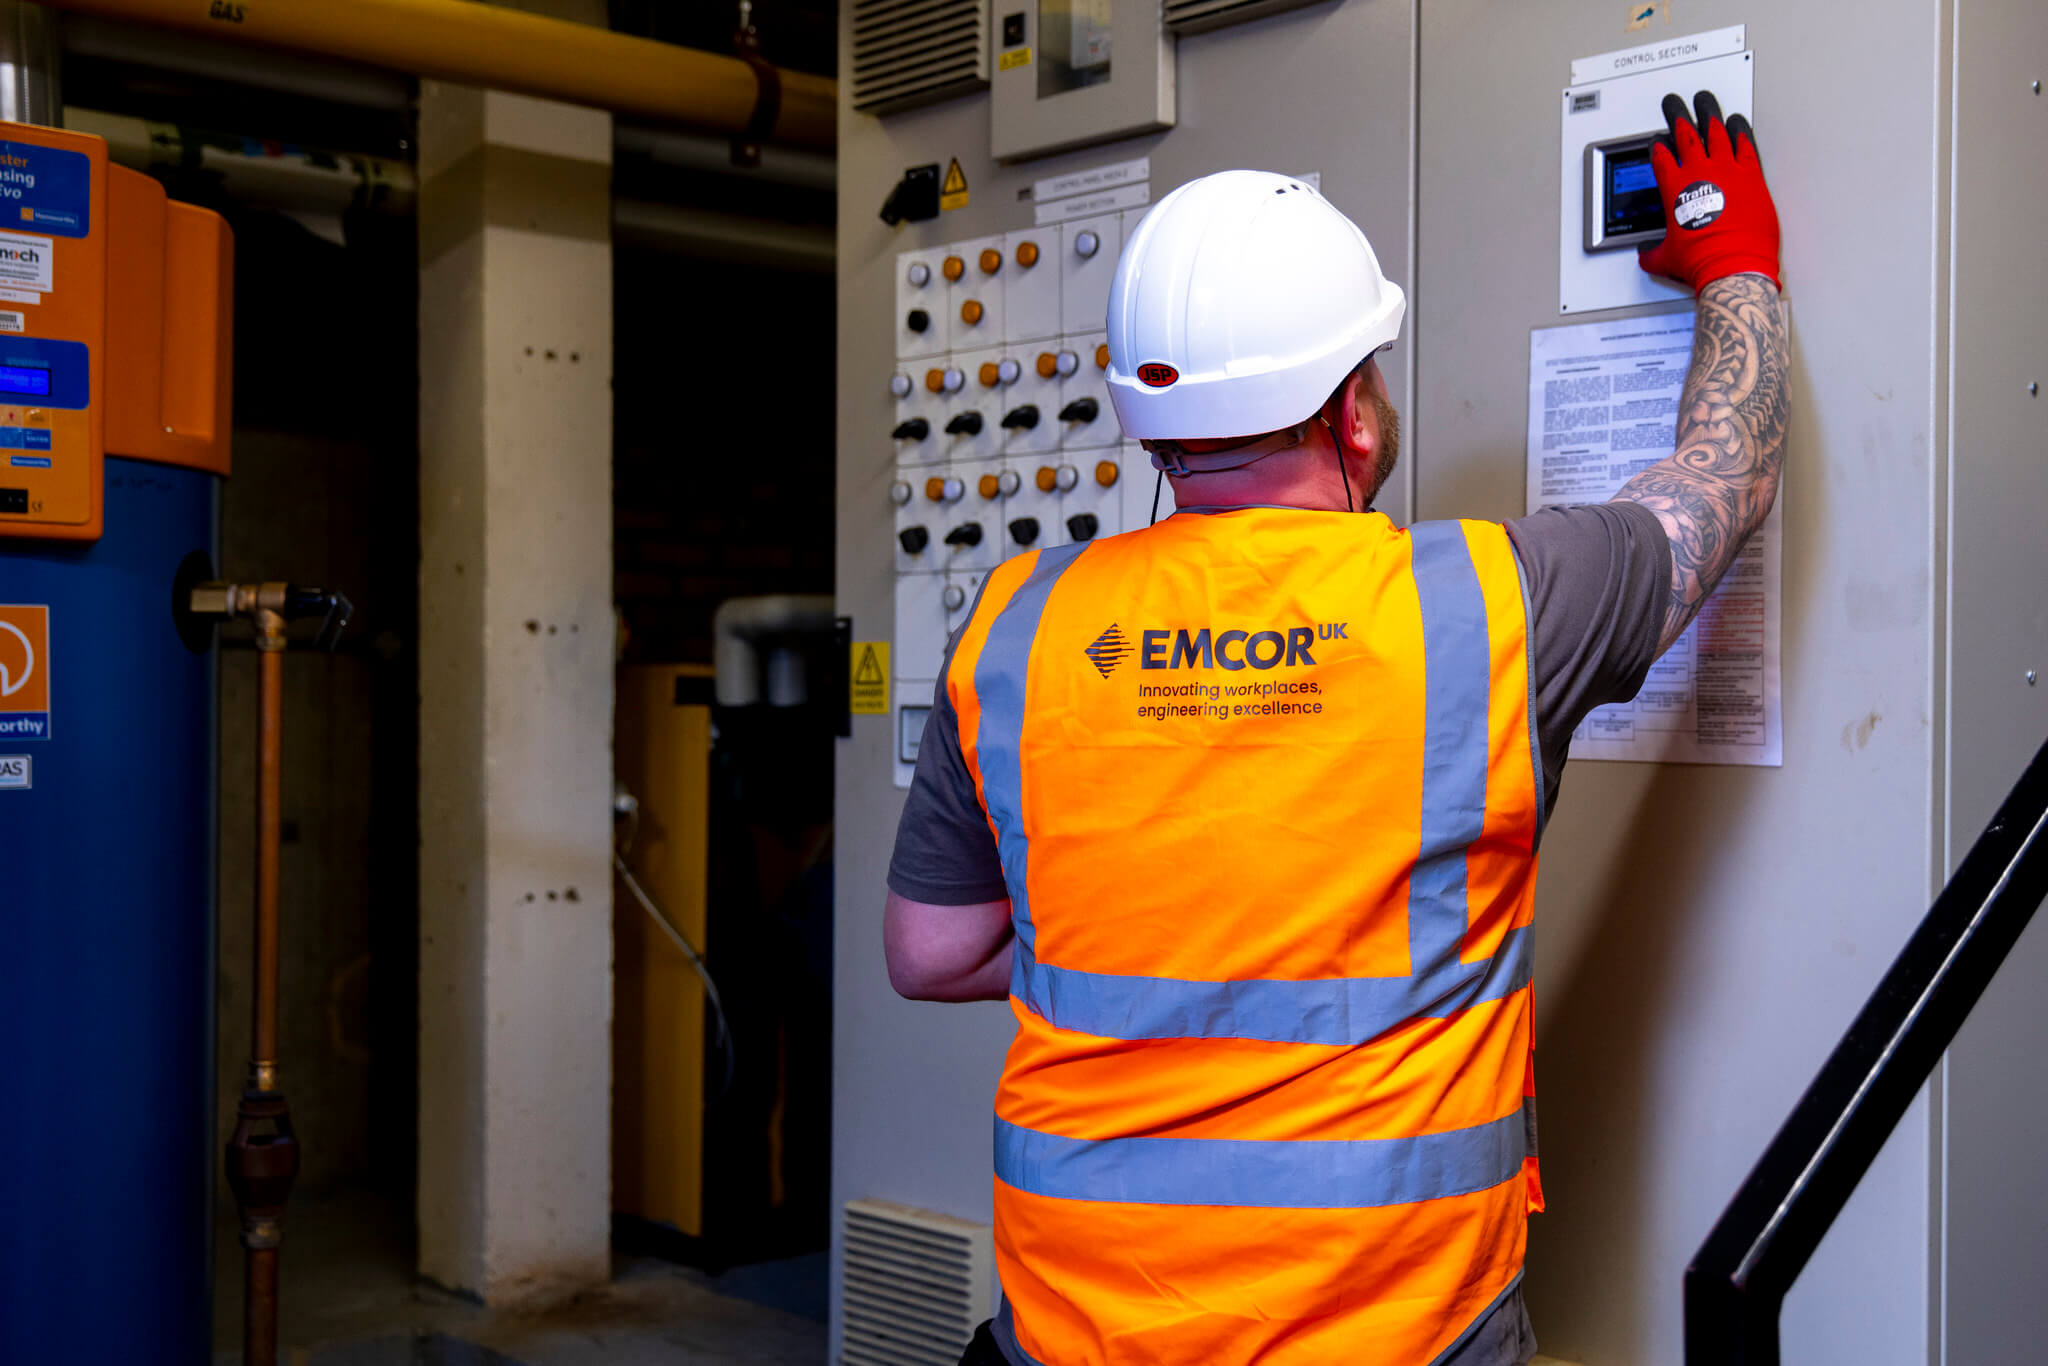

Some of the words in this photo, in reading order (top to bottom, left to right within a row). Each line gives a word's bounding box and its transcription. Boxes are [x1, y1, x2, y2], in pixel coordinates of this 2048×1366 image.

[1614, 53, 1655, 69] CONTROL
[1658, 42, 1698, 60] SECTION
[0, 168, 35, 188] sing
[1143, 368, 1171, 381] JSP
[1141, 627, 1317, 671] EMCOR
[1318, 623, 1348, 640] UK
[1139, 683, 1220, 700] Innovating
[1225, 681, 1322, 698] workplaces,
[1138, 702, 1228, 721] engineering
[1233, 700, 1322, 716] excellence
[0, 761, 23, 776] AS
